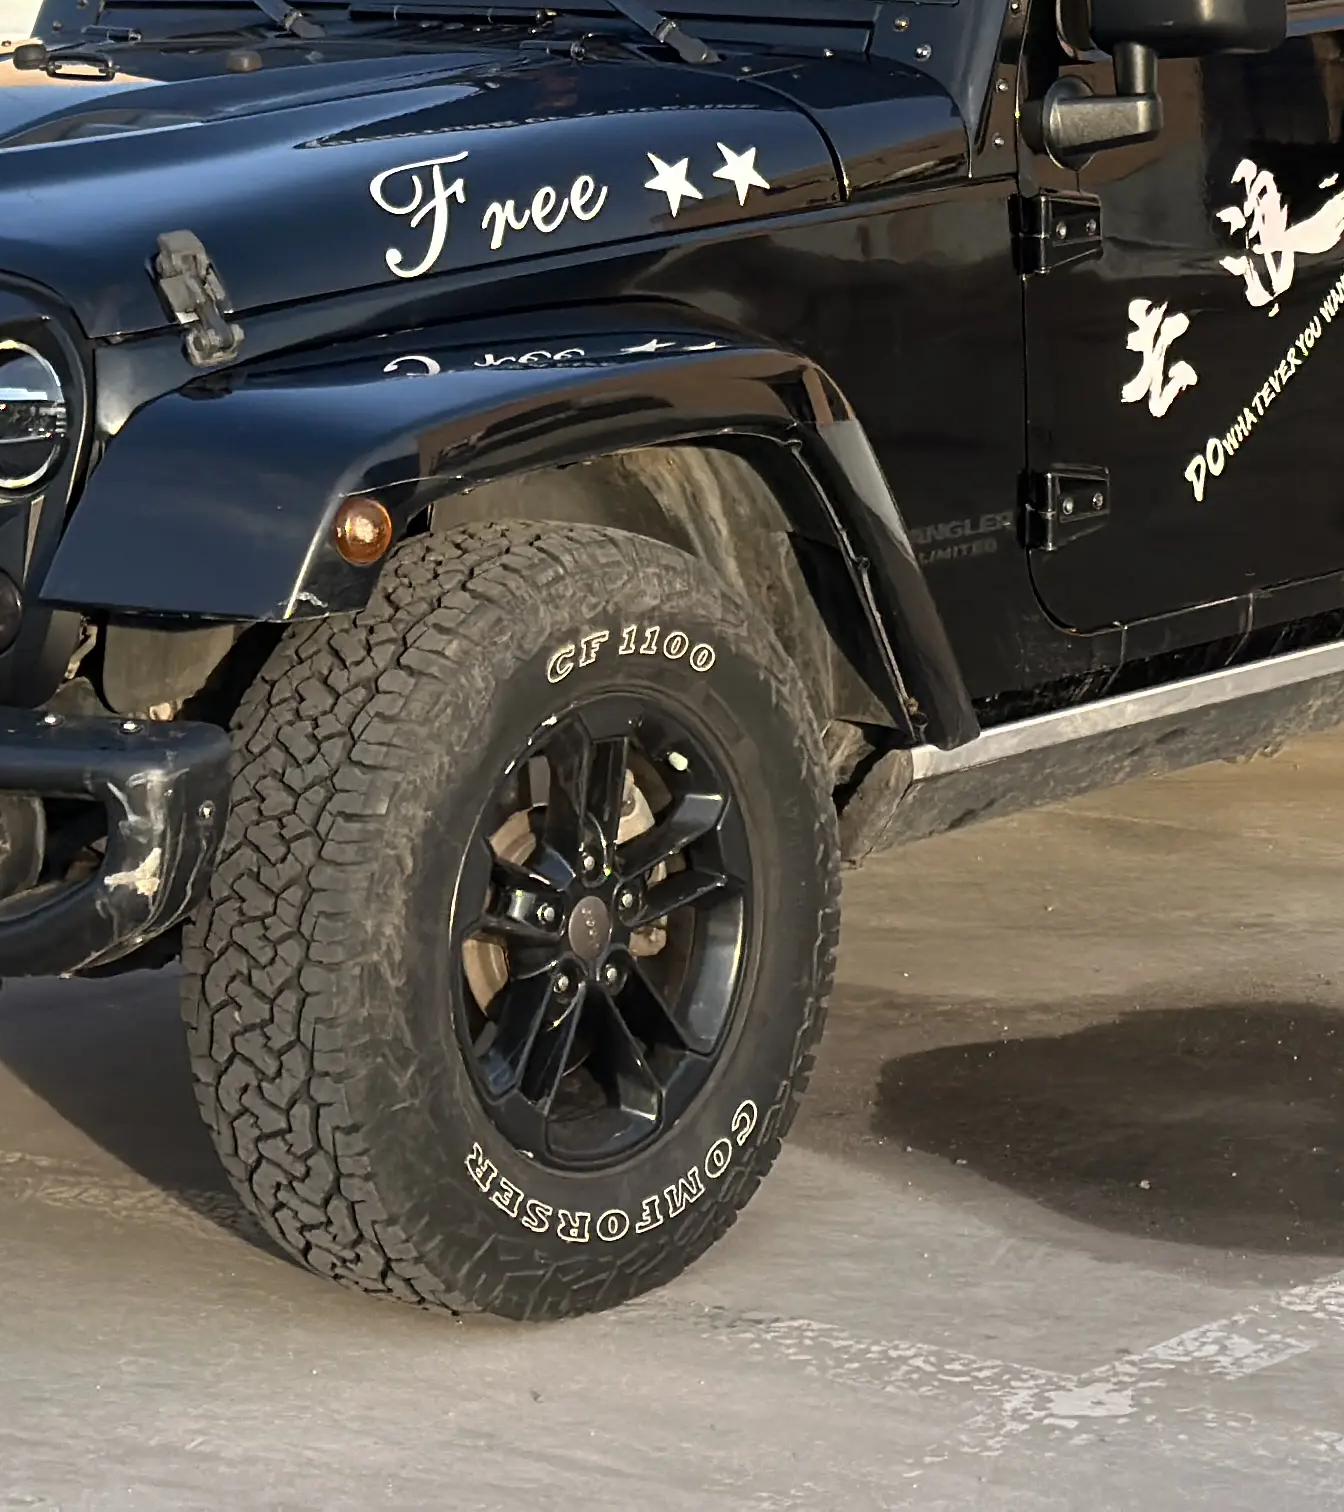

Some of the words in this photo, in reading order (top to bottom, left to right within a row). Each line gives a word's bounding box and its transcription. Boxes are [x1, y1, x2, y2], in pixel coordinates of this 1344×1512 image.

[369, 150, 608, 278] Free
[1184, 437, 1225, 502] DO
[1222, 347, 1303, 456] WHATEVER
[1295, 315, 1322, 357] YOU
[908, 509, 1015, 544] ANGLER
[545, 622, 610, 684] CF
[618, 619, 716, 672] 1100
[463, 1098, 758, 1244] COMFORSER
